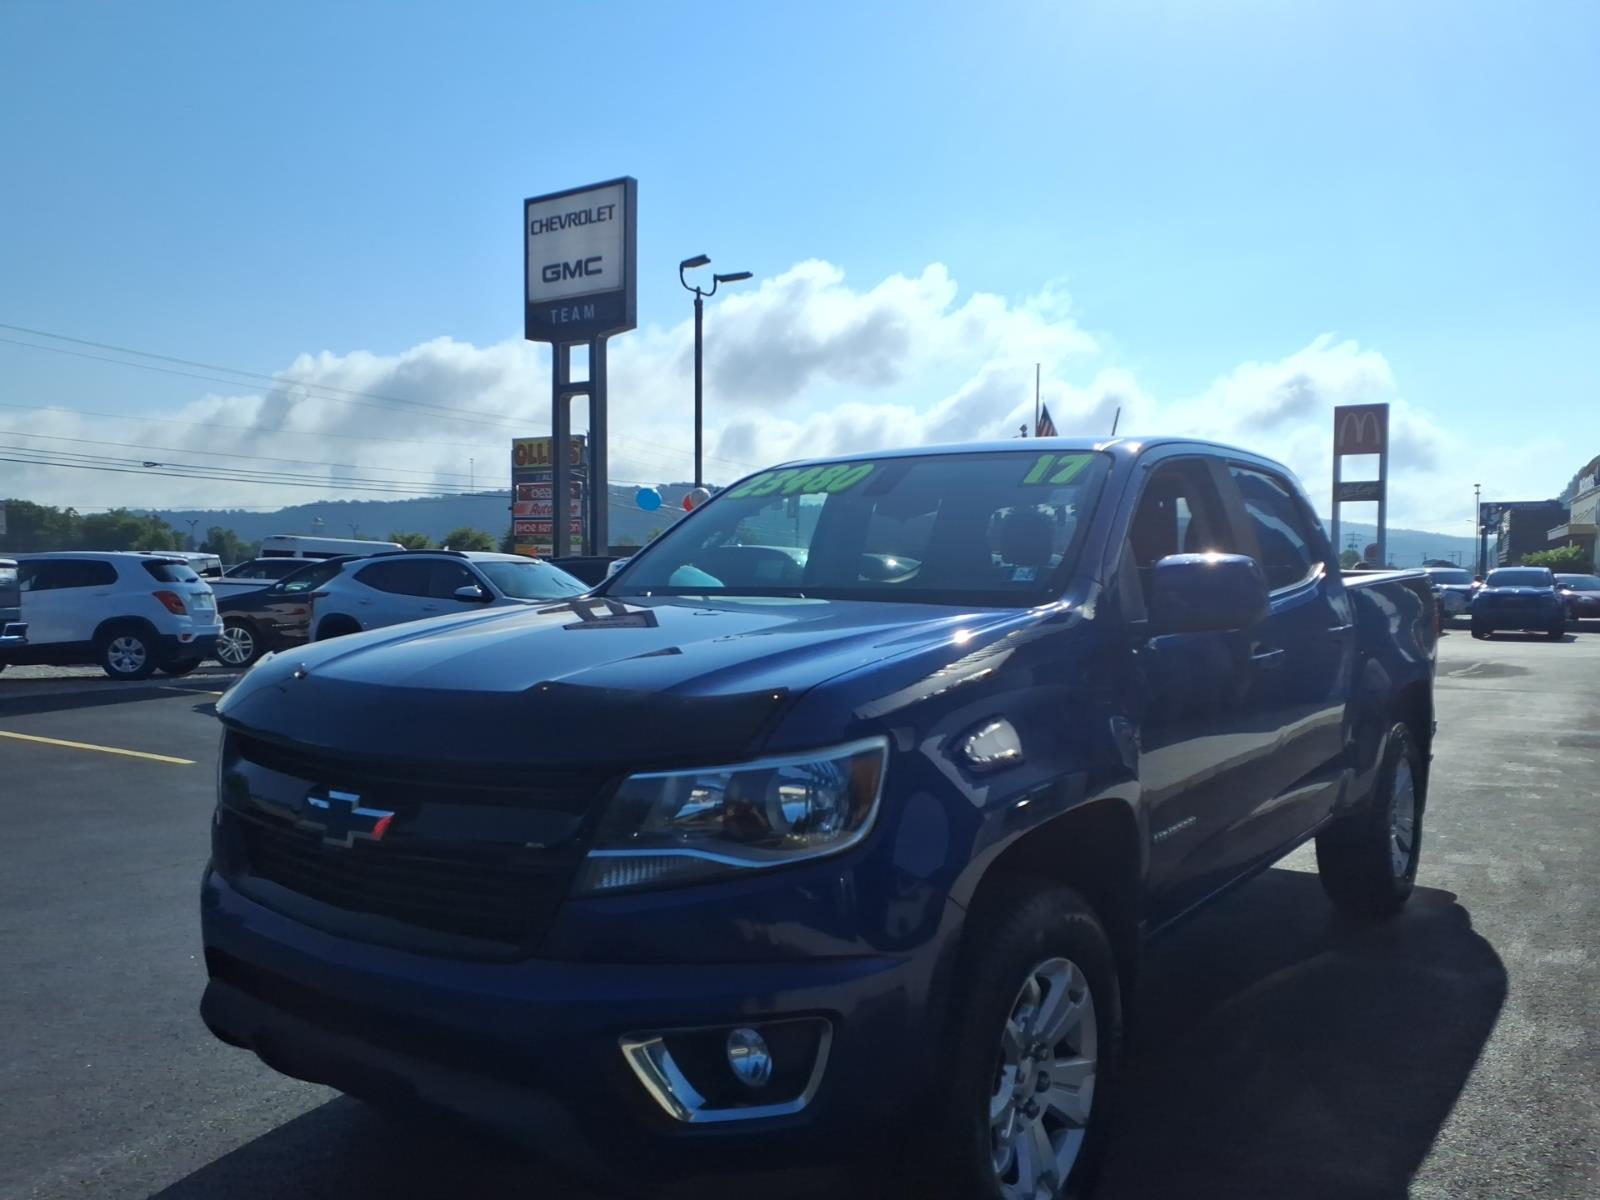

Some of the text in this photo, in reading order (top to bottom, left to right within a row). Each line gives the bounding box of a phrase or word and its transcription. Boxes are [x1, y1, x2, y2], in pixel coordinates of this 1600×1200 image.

[530, 204, 616, 236] CHEVROLET
[541, 255, 603, 284] GMC
[550, 303, 596, 325] TEAM
[1022, 453, 1095, 486] 17
